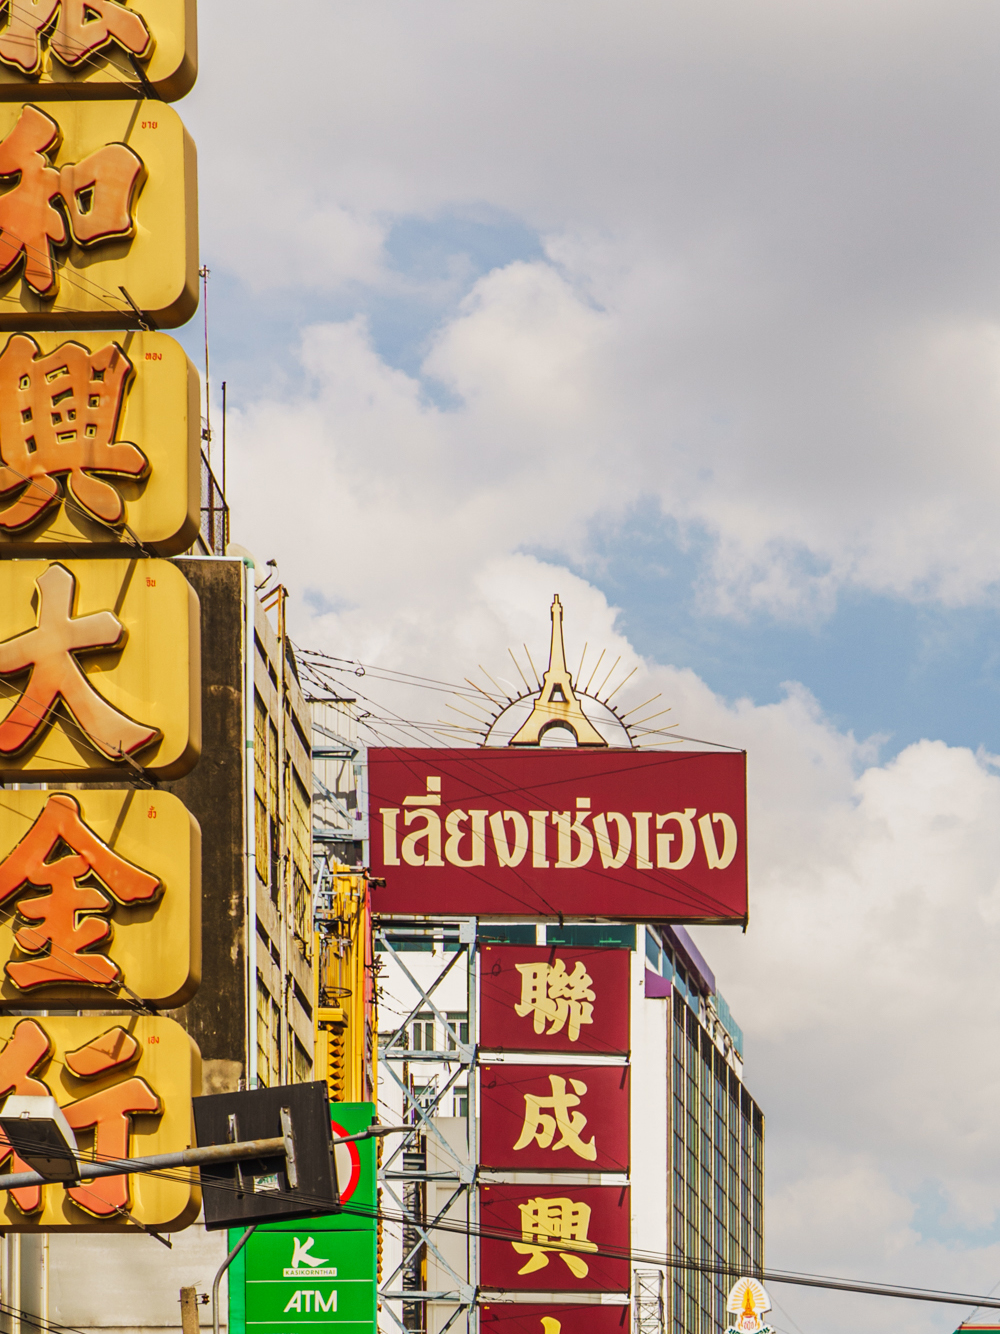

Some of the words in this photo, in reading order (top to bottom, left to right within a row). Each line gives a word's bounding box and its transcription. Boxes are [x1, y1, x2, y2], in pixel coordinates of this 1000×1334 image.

[141, 121, 158, 130] ขาย
[145, 352, 163, 361] ทอง
[283, 1290, 338, 1313] ATM
